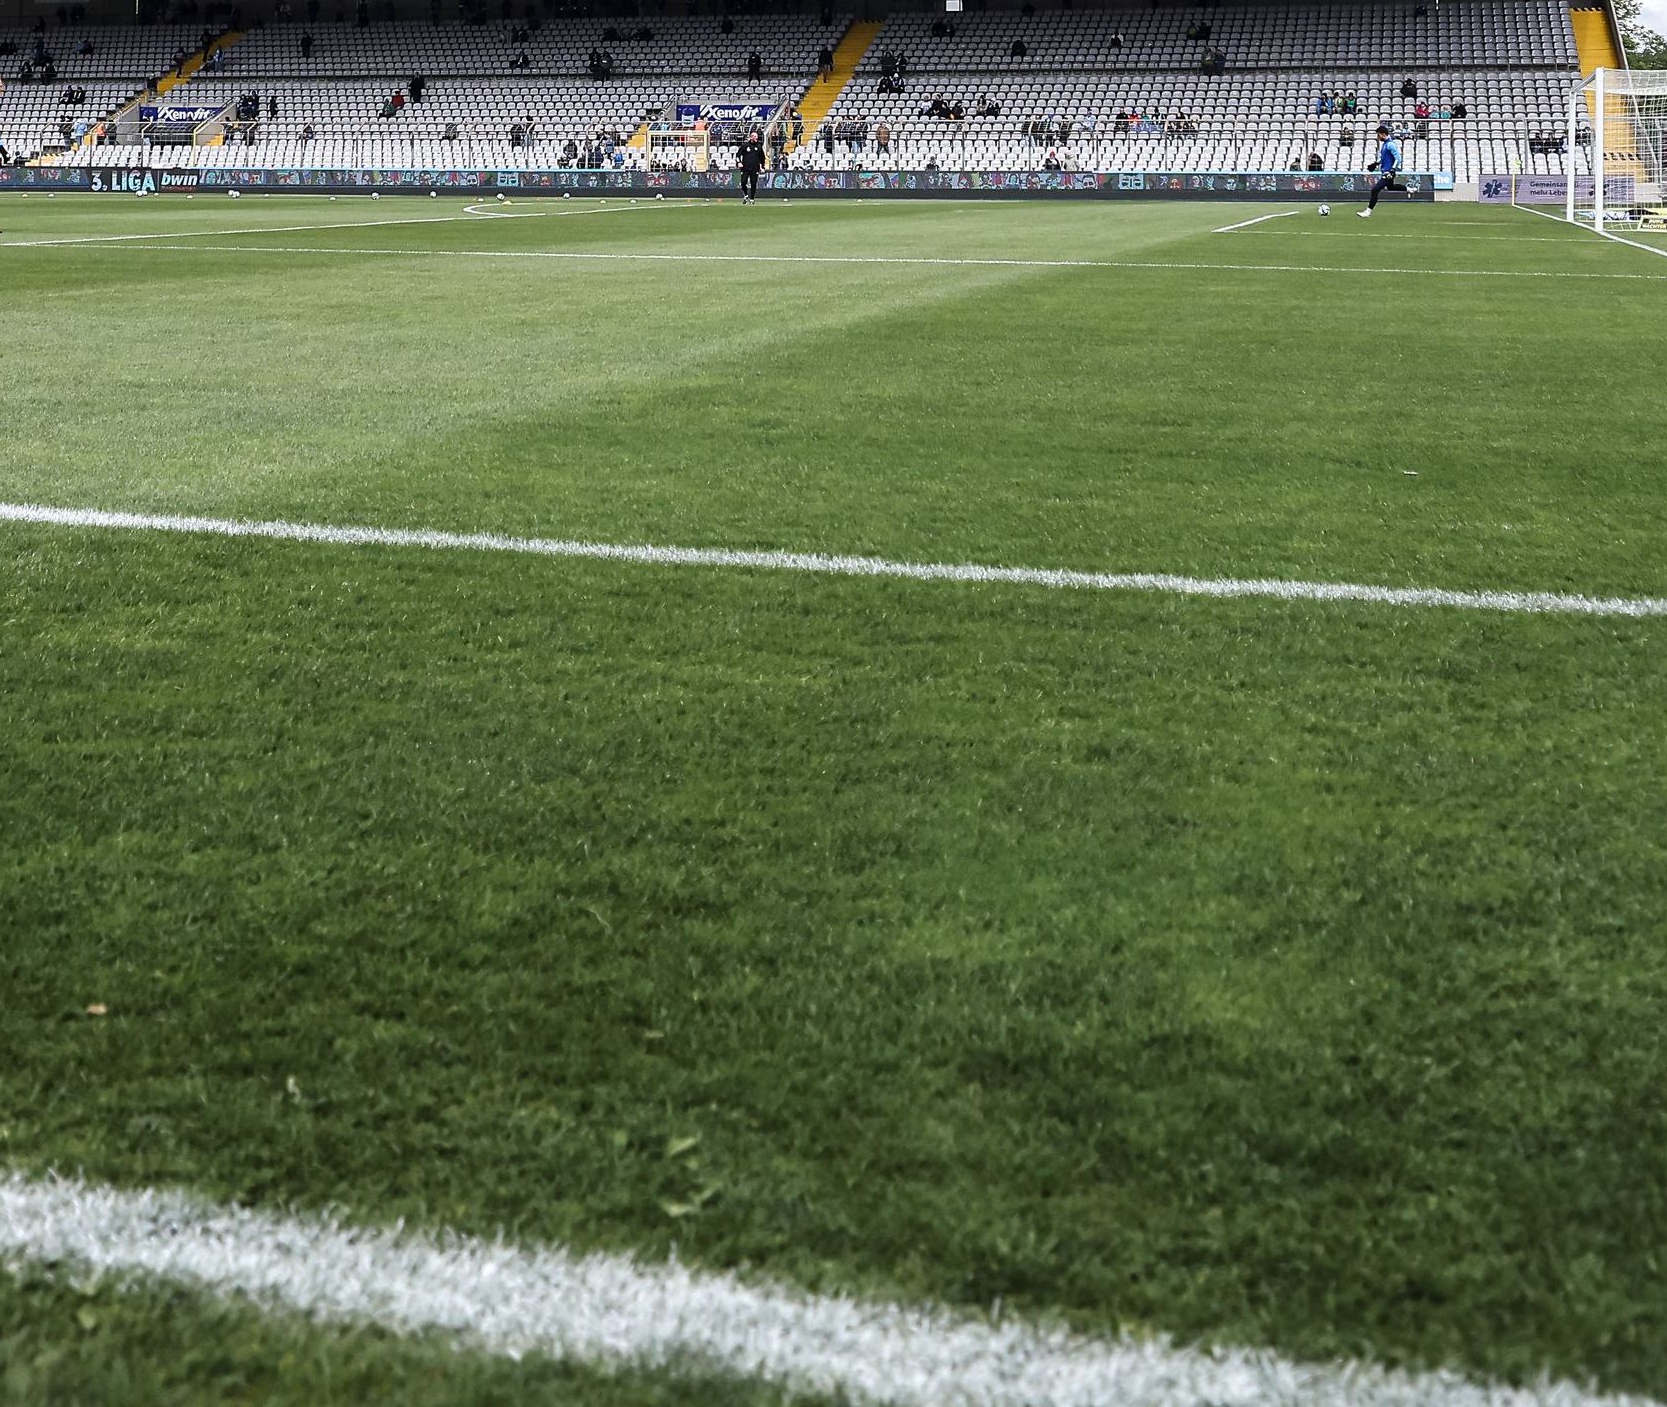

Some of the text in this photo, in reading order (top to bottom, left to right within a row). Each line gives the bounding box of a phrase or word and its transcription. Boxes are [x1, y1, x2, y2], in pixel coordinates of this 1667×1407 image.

[91, 169, 155, 191] 3. LIGA
[161, 172, 198, 186] bwin
